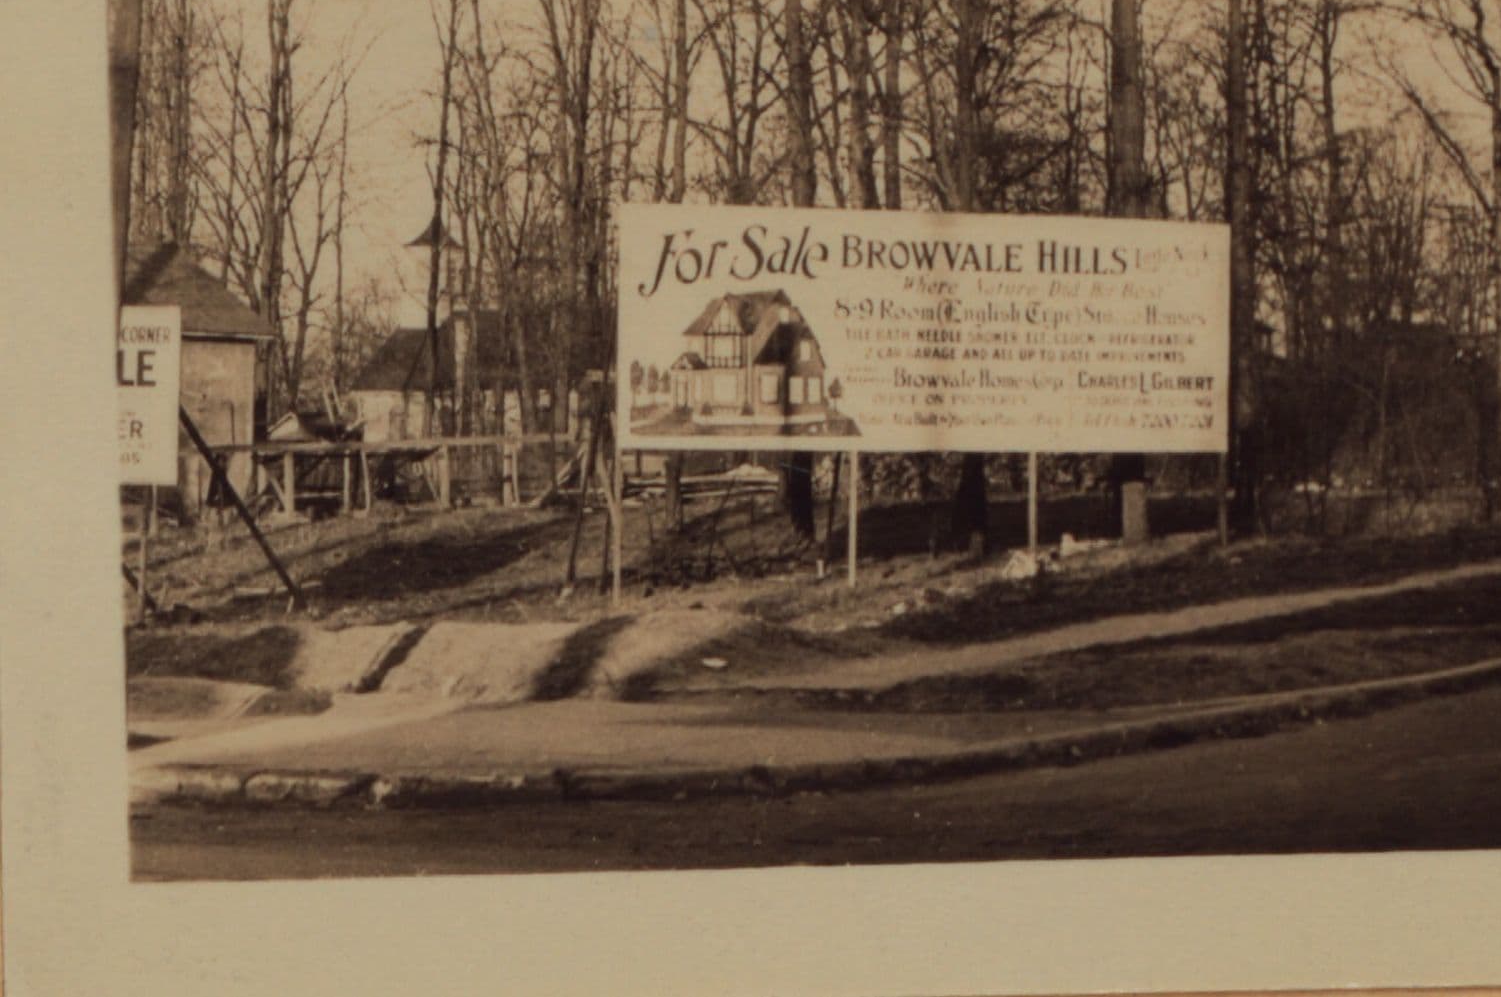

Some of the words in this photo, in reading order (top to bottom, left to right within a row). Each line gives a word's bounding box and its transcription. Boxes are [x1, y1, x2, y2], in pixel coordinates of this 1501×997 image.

[638, 230, 728, 297] For
[730, 224, 829, 281] Sale
[841, 234, 1023, 273] BROWVALE
[1037, 240, 1128, 275] HILLS
[121, 325, 171, 344] CORNER
[916, 329, 961, 343] NEEDLE
[962, 348, 988, 361] AND
[991, 348, 1013, 361] ALL
[1018, 348, 1035, 362] UP
[1040, 349, 1056, 362] TO
[1151, 370, 1215, 392] GILBERT
[924, 393, 945, 406] ON
